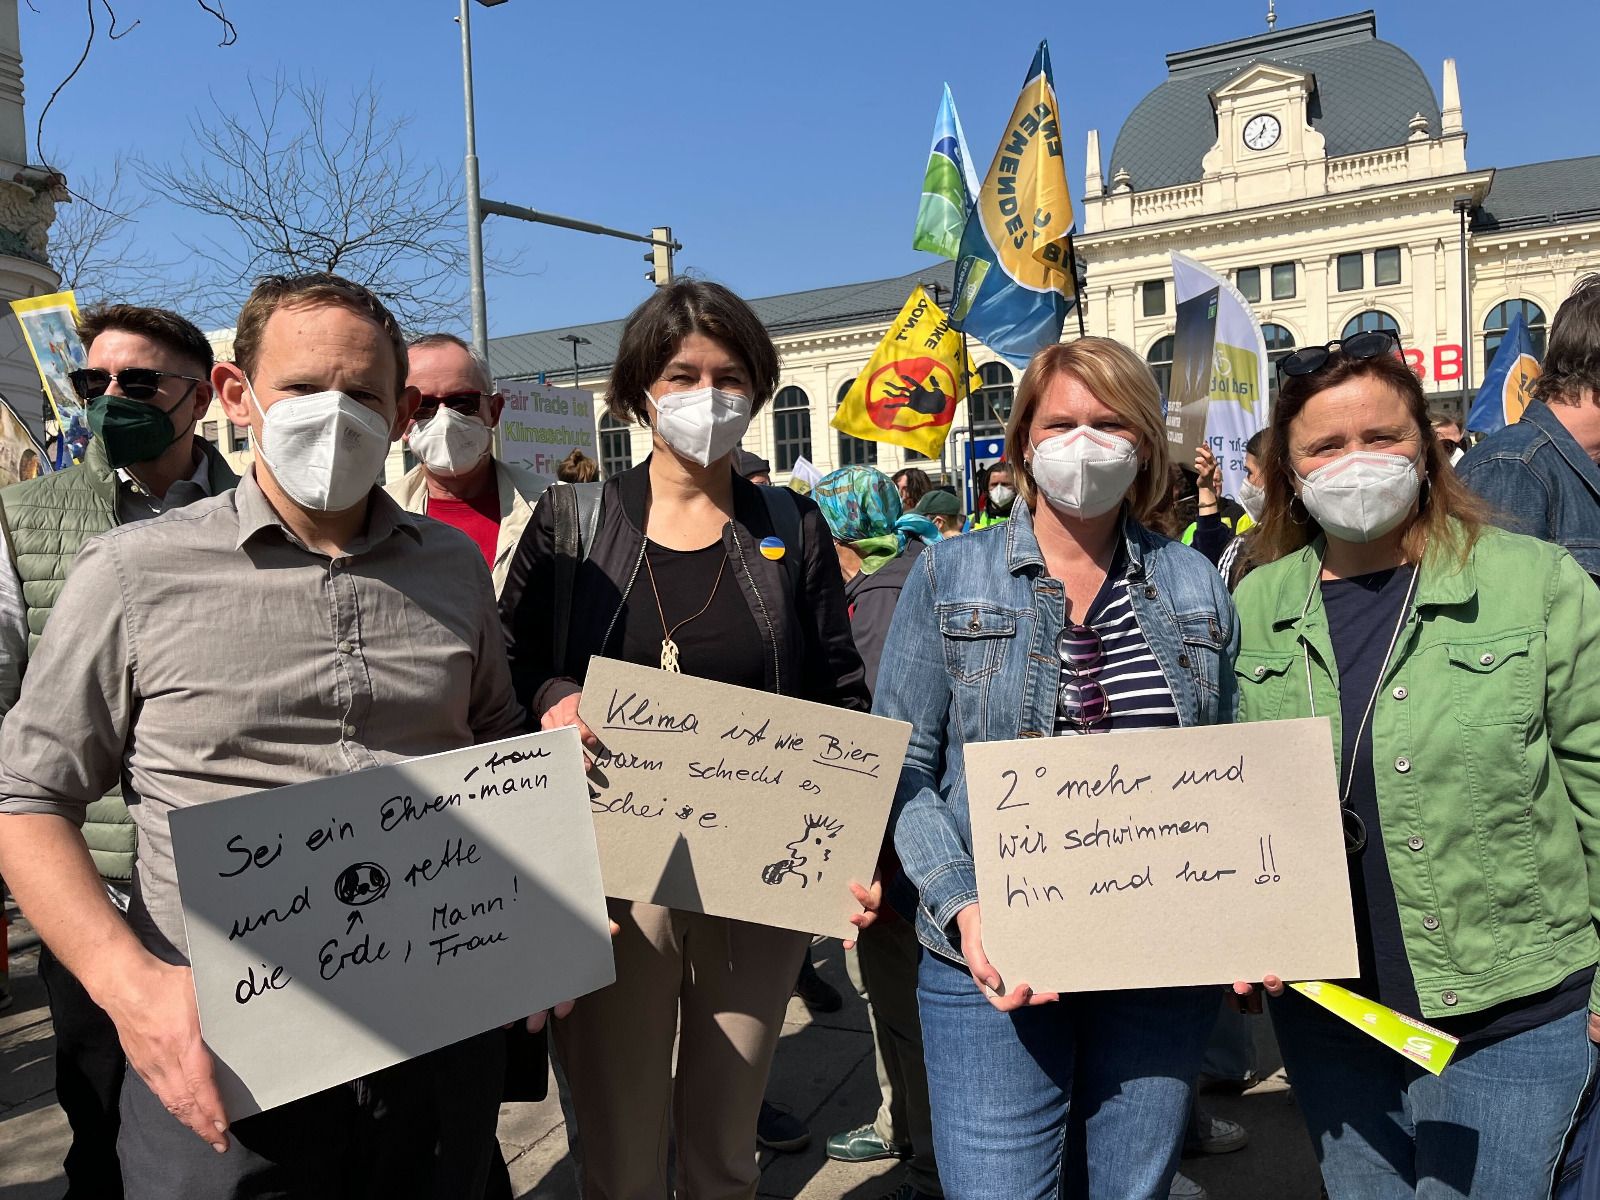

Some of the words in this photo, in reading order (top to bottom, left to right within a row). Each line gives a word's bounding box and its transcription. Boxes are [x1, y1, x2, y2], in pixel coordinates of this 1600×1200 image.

[501, 388, 529, 411] Fair
[530, 391, 569, 415] Trade
[572, 397, 589, 417] ist
[504, 420, 592, 446] Klimaschutz
[606, 688, 699, 735] Klima
[720, 711, 771, 746] ist
[774, 733, 805, 752] wie
[812, 733, 881, 779] Bier,
[798, 778, 822, 795] es
[1056, 763, 1152, 799] mehr
[1171, 754, 1245, 791] und
[218, 834, 284, 878] Sei
[304, 816, 355, 852] ein
[1063, 815, 1210, 851] schwimmen
[227, 886, 311, 941] und
[403, 837, 482, 886] rette
[431, 874, 521, 932] Mann!
[1006, 874, 1065, 909] hin
[1089, 866, 1153, 898] und
[234, 962, 293, 1005] die
[428, 931, 511, 966] Frau
